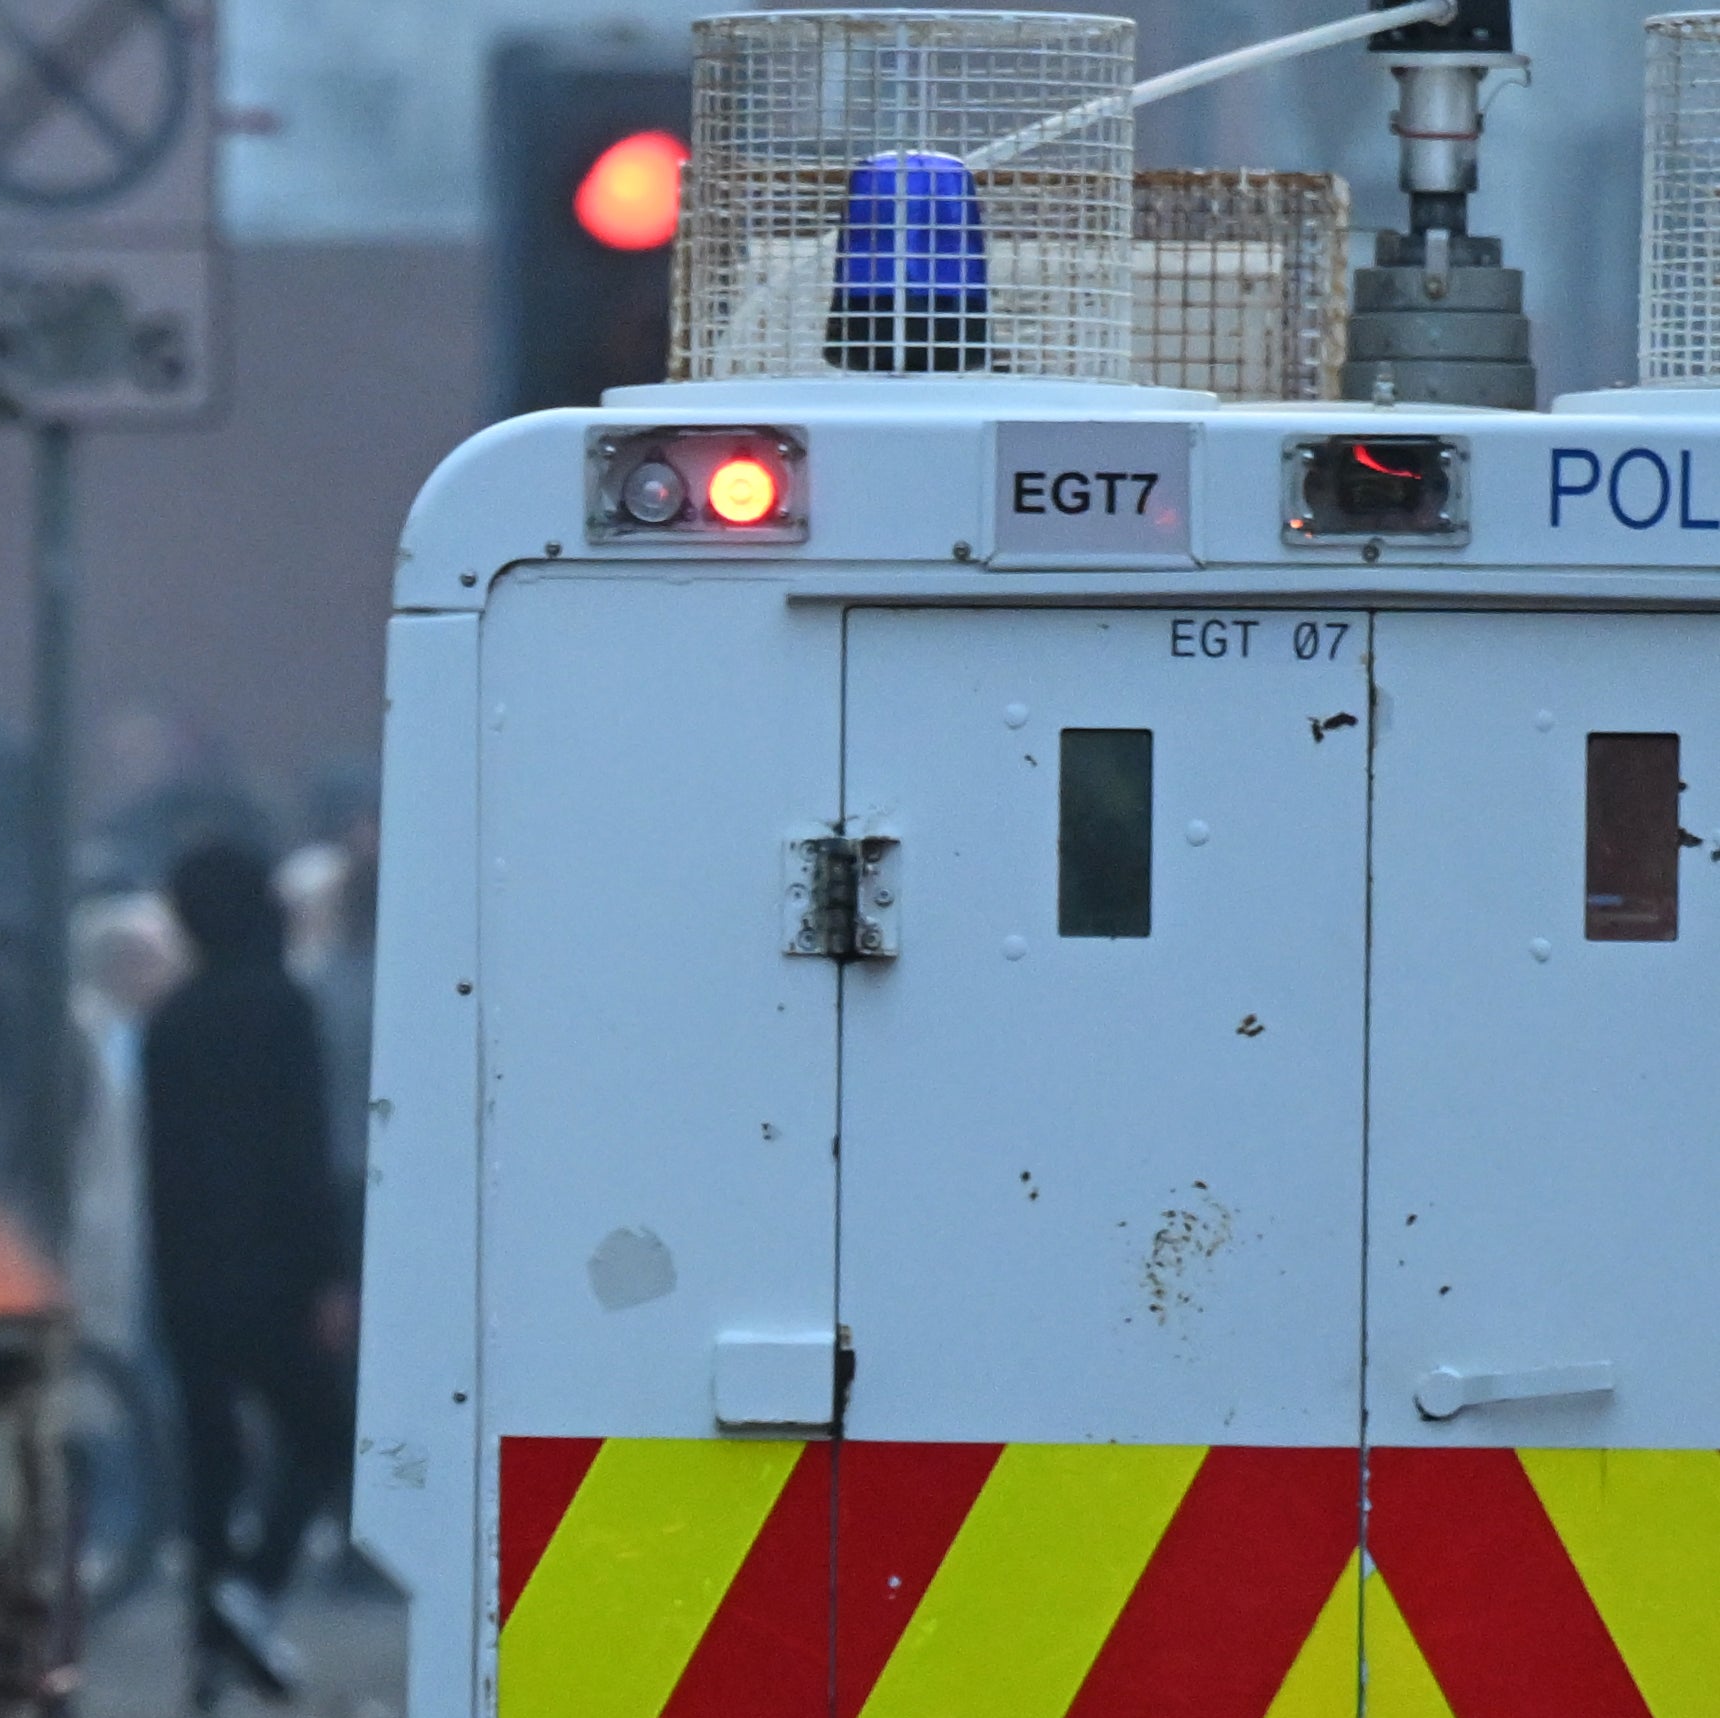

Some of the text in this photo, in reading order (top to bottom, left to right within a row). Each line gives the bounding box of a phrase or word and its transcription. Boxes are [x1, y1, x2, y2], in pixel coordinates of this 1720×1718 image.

[1013, 470, 1160, 515] EGT7
[1549, 447, 1720, 530] POL
[1170, 616, 1351, 661] EGT 07
